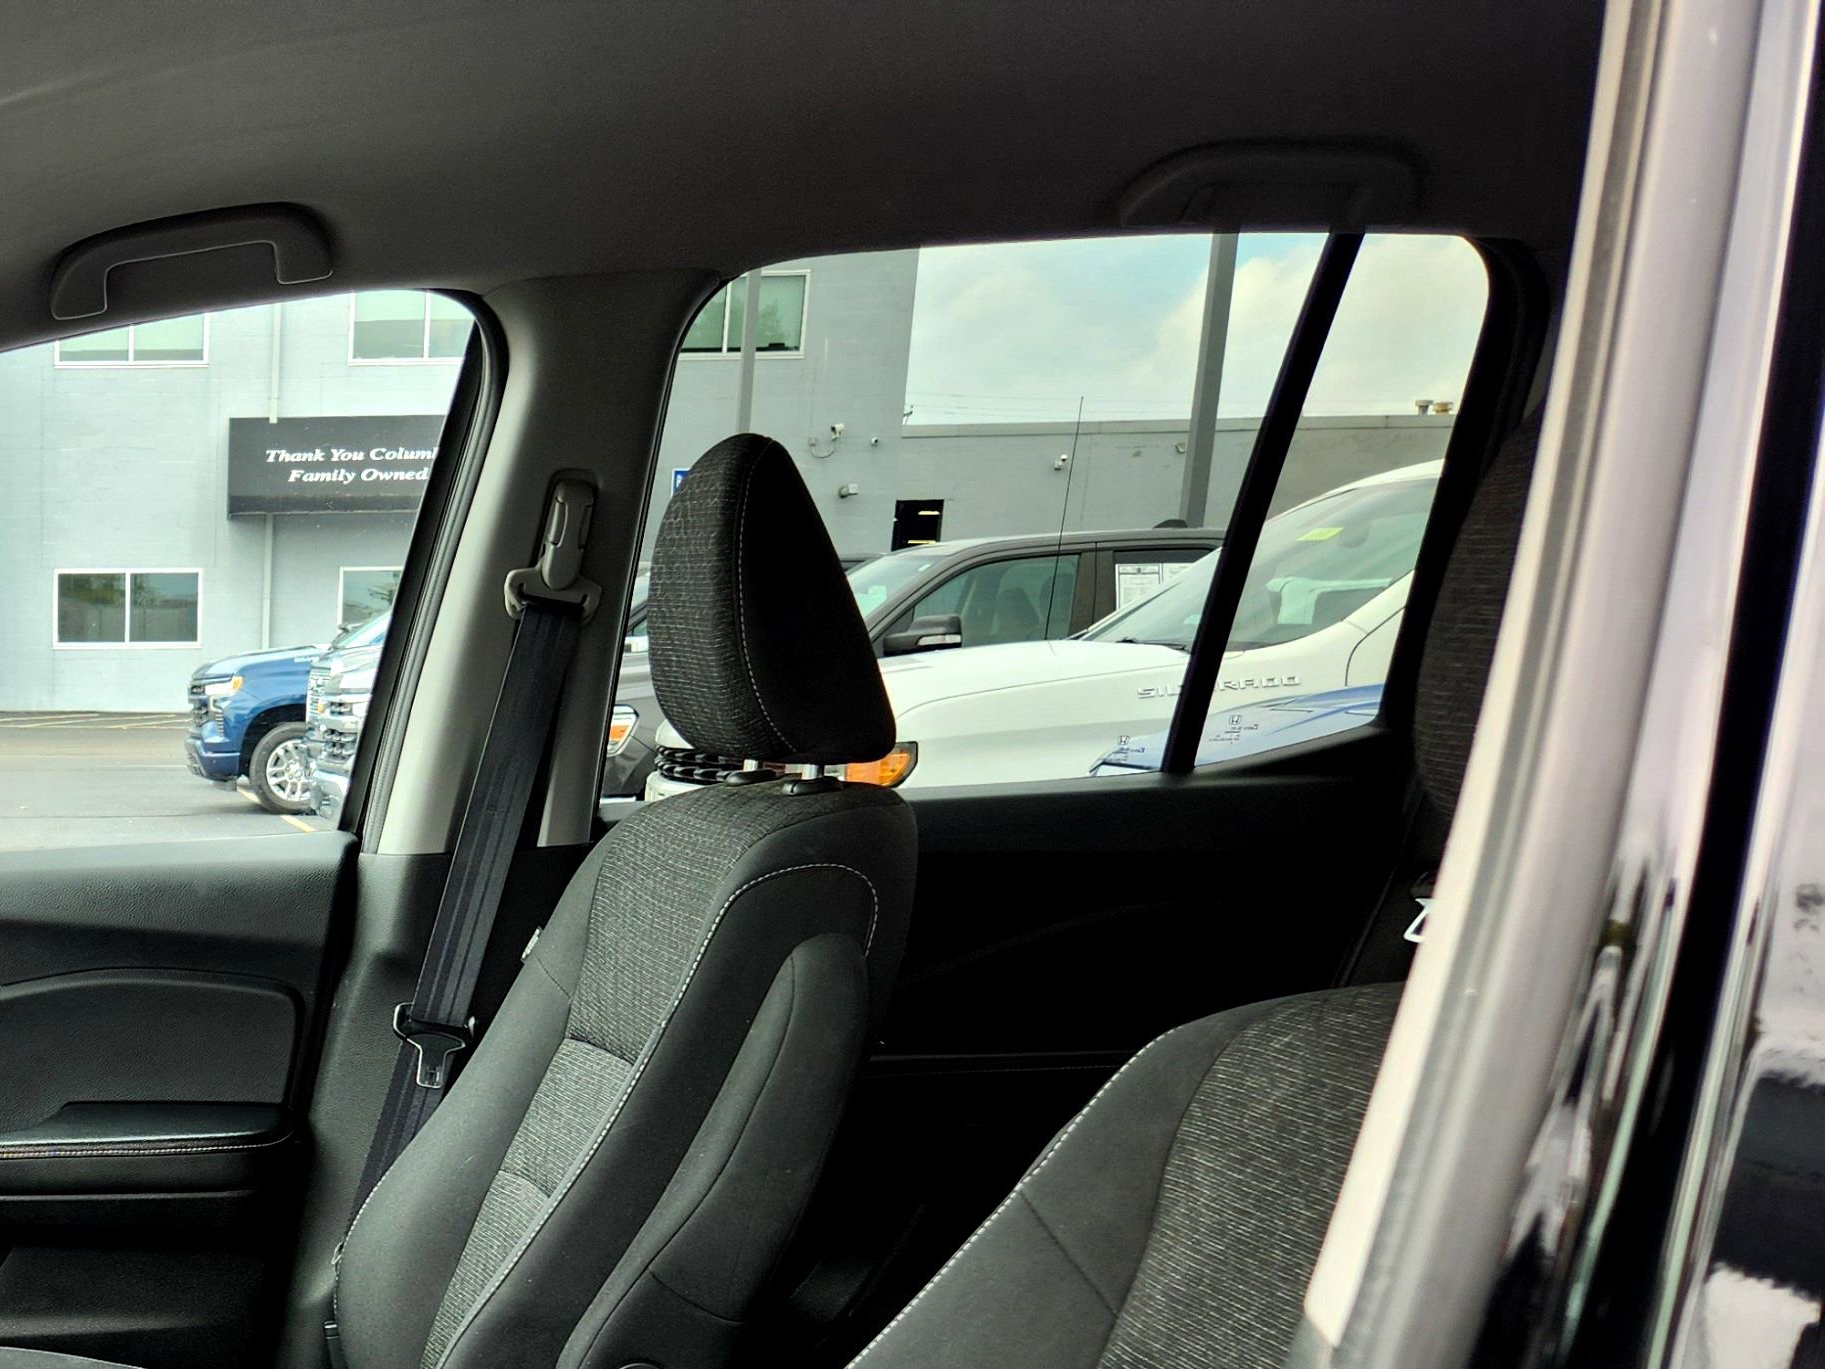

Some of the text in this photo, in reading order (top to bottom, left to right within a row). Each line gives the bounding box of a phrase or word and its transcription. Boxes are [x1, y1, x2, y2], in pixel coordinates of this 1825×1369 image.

[265, 448, 325, 463] Thank
[330, 448, 365, 462] You
[287, 467, 428, 485] Family Owned
[1136, 675, 1303, 699] SILRADO
